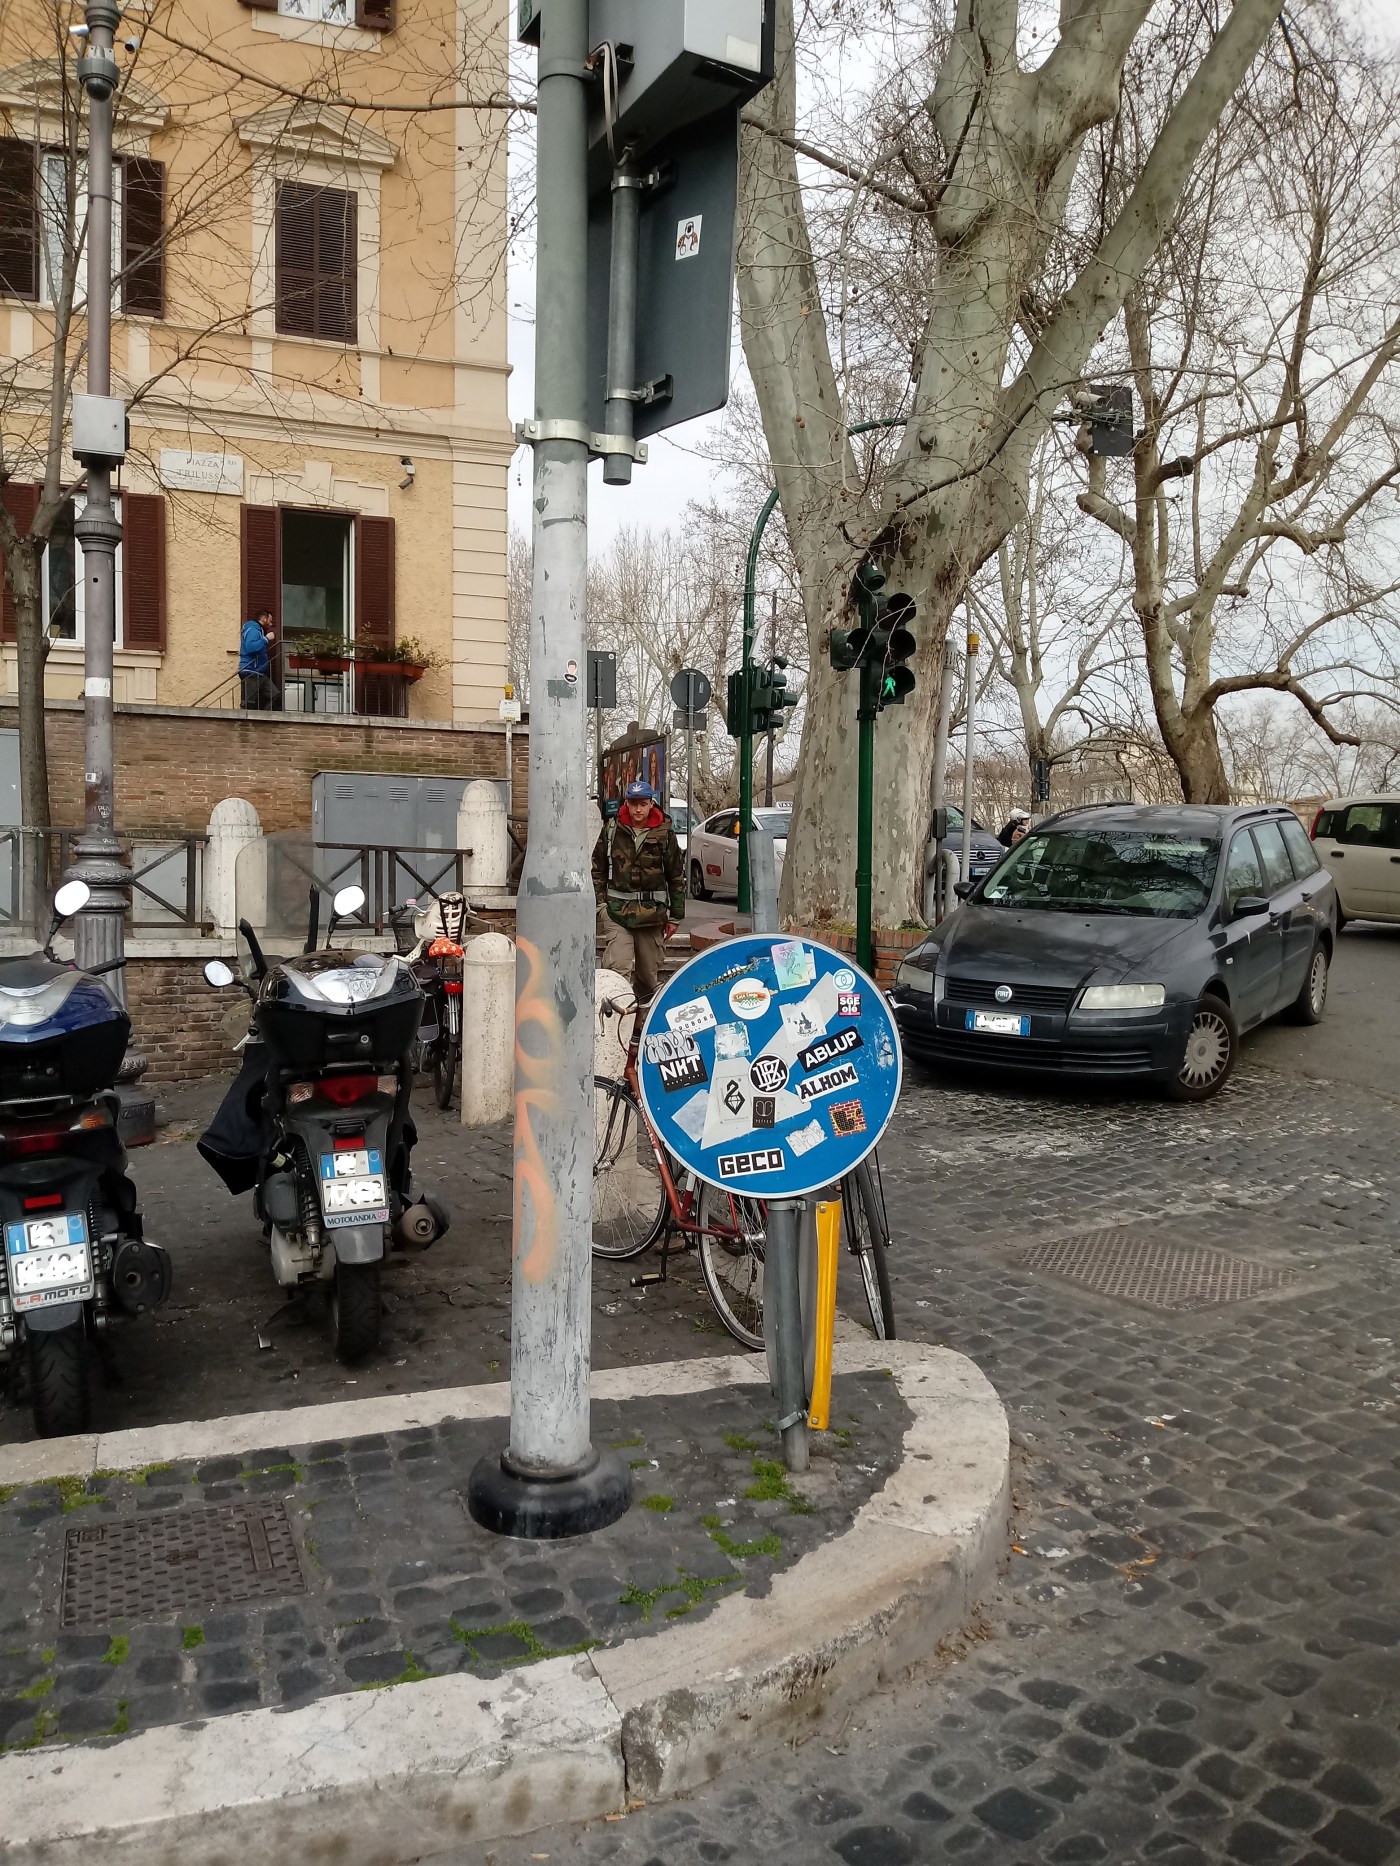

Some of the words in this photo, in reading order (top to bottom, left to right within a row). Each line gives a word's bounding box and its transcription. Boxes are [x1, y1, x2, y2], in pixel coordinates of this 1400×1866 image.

[187, 458, 220, 469] PIAZZA
[839, 997, 861, 1006] SGE
[805, 1031, 857, 1068] ABLUP
[800, 1065, 857, 1100] ALHOM
[327, 1213, 377, 1225] MOTOLANDIA
